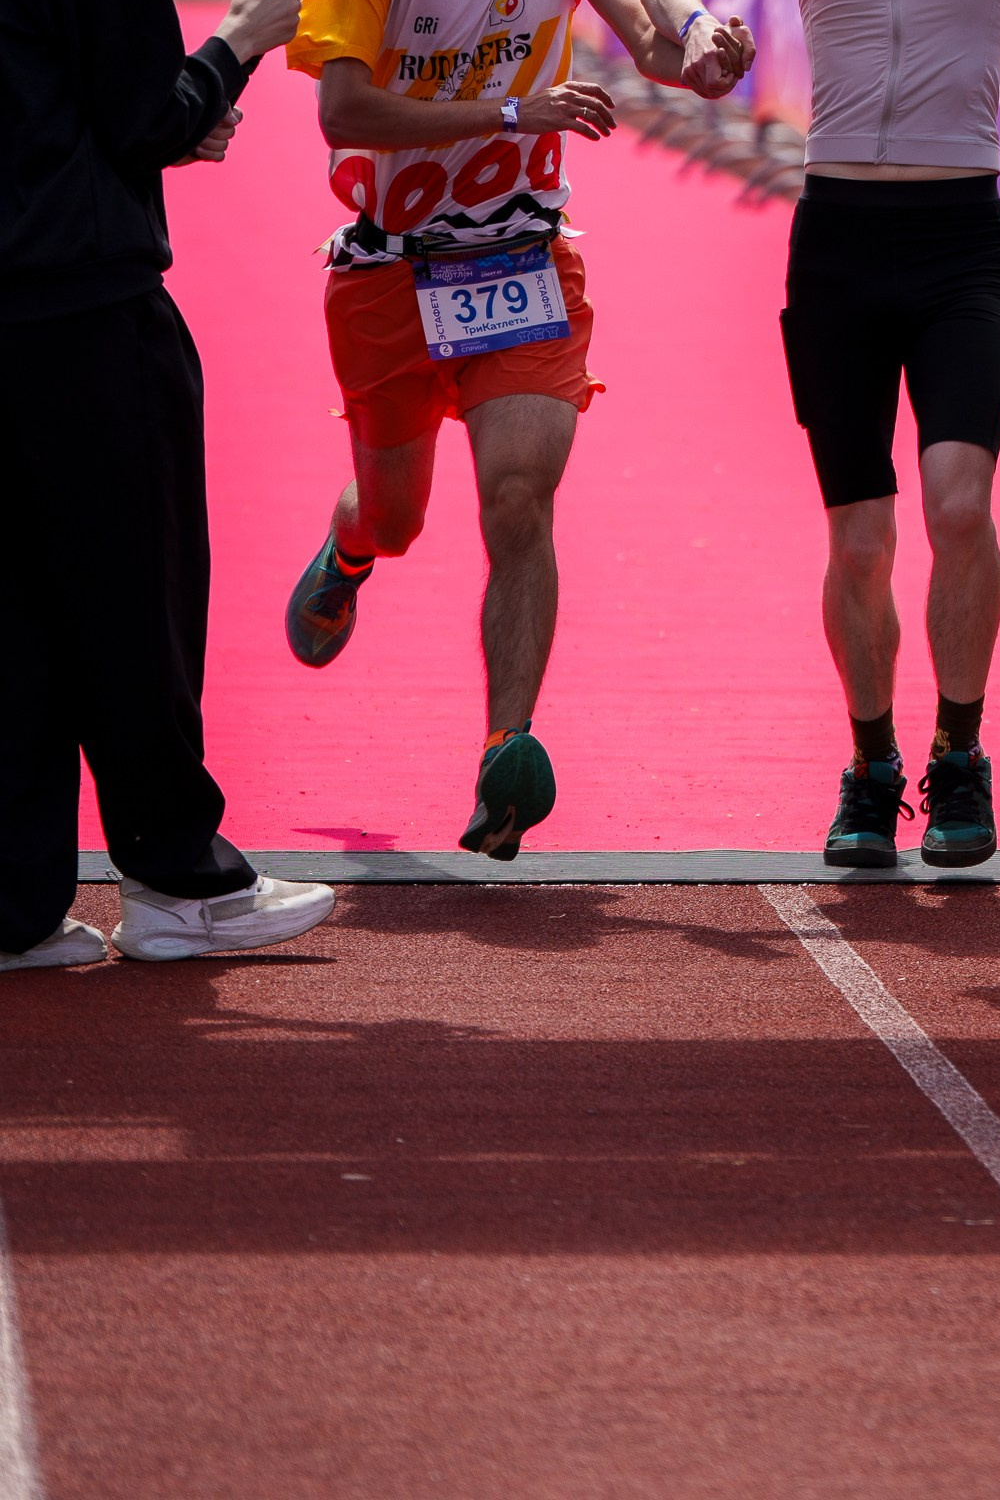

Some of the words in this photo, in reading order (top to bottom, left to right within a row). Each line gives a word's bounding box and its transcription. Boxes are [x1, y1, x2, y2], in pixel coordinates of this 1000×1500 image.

[413, 16, 439, 34] GRi
[451, 280, 528, 323] 379
[535, 272, 554, 321] ЭСТАФЕТА
[429, 290, 447, 341] ЭСТАФЕТА
[462, 316, 529, 336] ТриКатлеты
[443, 344, 449, 353] 2
[461, 343, 489, 353] СПРИНТ
